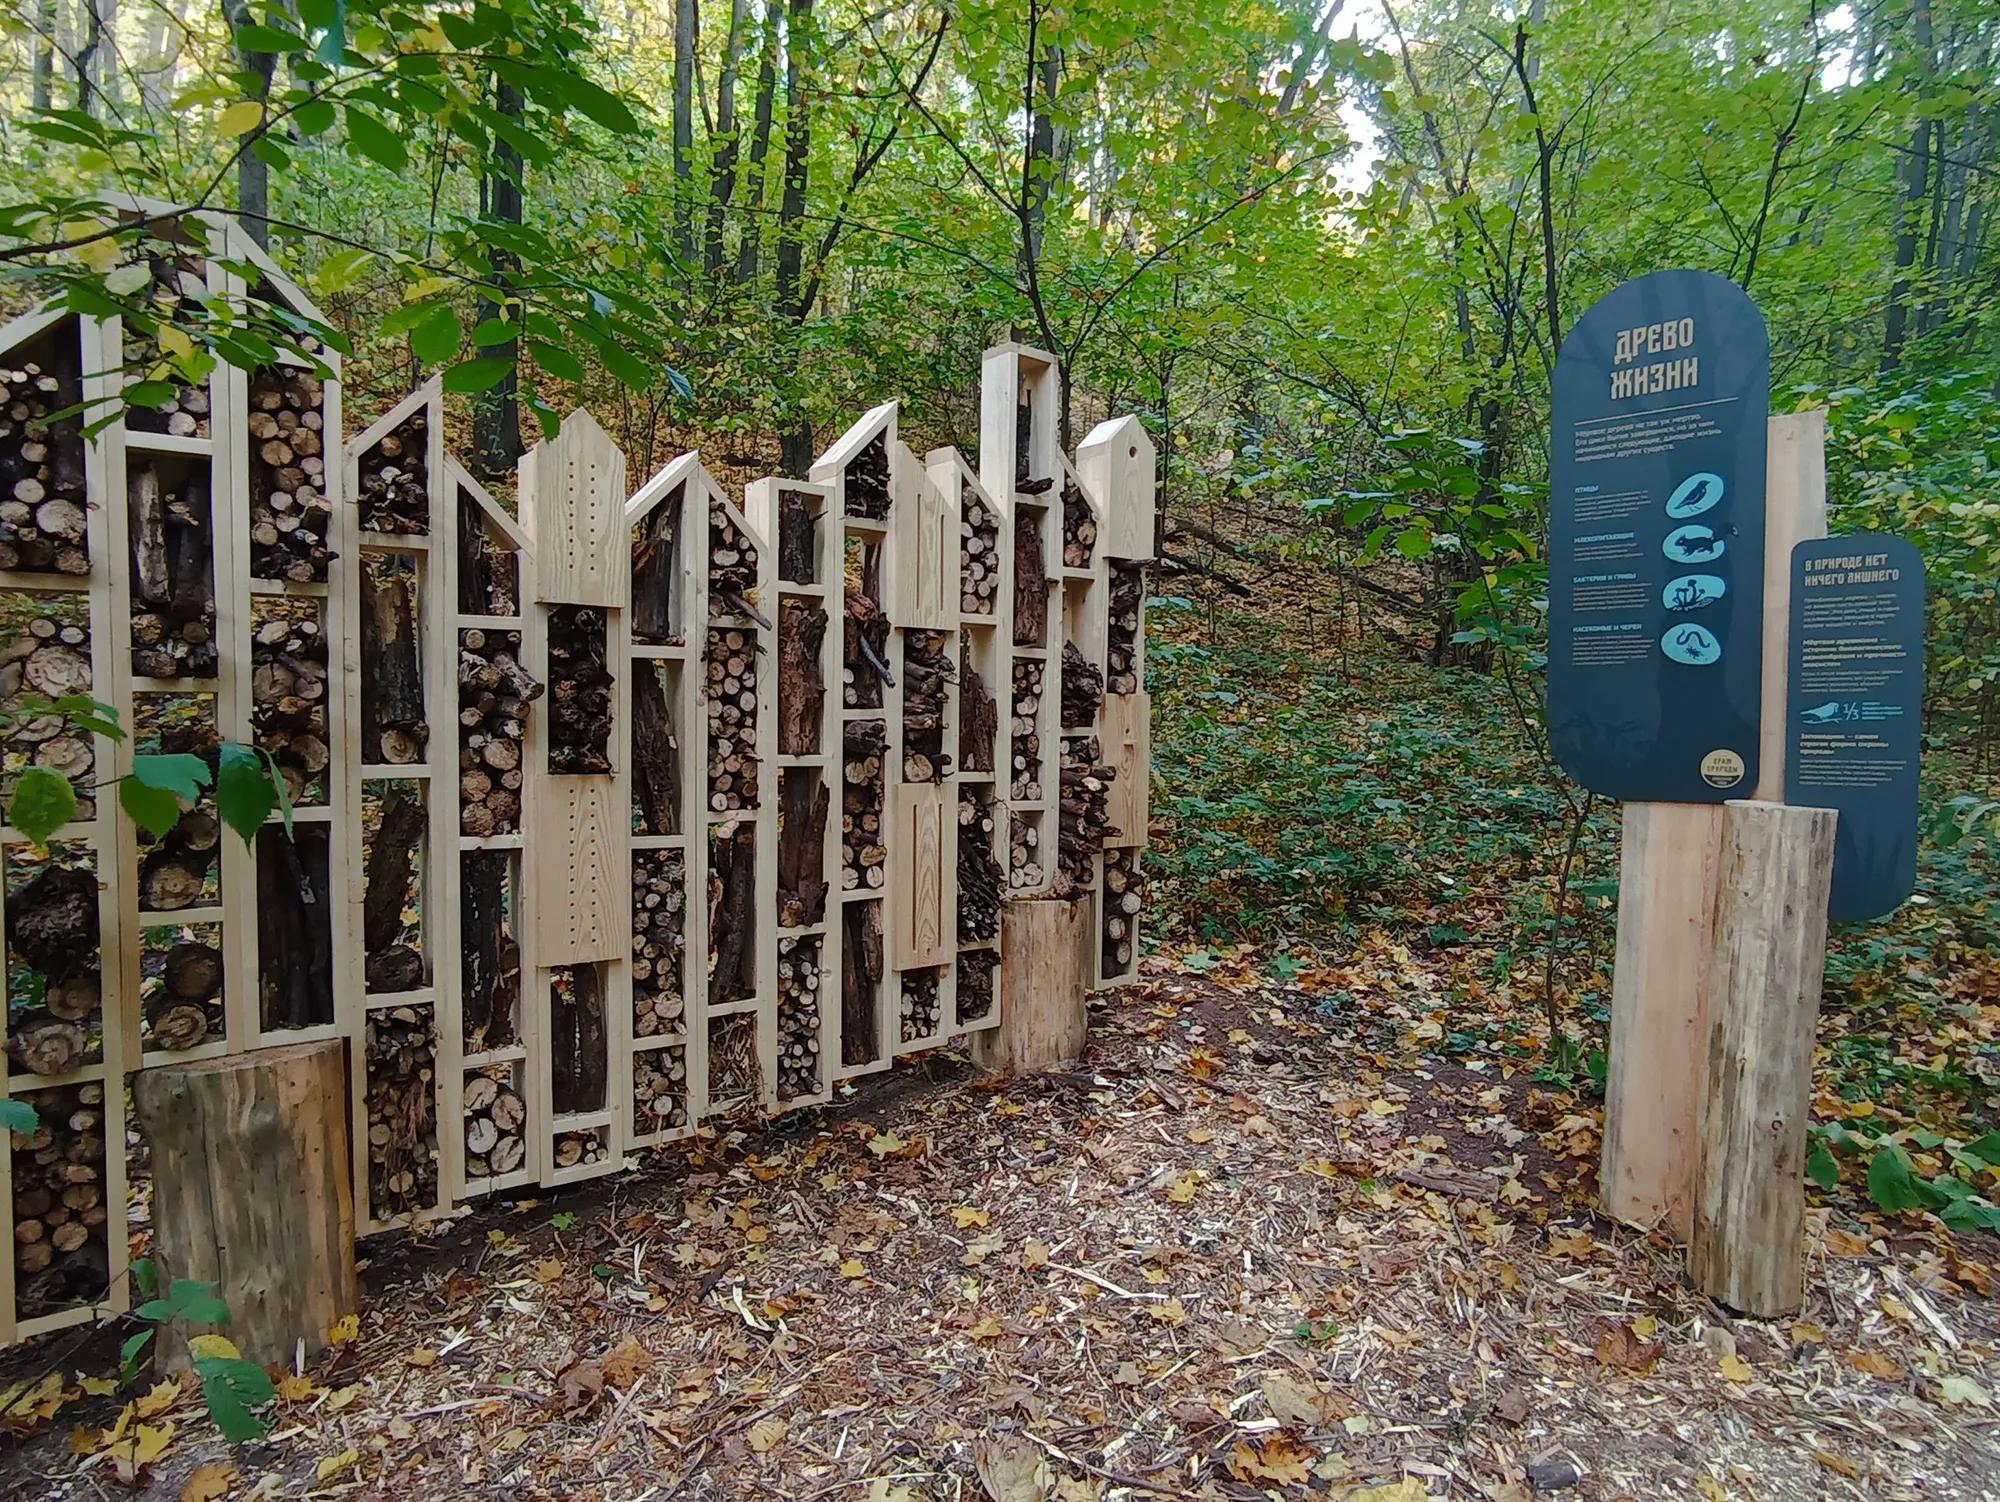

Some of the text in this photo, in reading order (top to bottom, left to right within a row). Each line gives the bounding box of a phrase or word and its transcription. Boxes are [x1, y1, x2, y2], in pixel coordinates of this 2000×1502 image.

[1614, 317, 1694, 365] ДРЕВО
[1610, 357, 1698, 400] ЖИЗНИ
[1804, 554, 1889, 571] В ПРИРОДЕ НЕТ
[1804, 569, 1900, 587] НИЧЕГО ЛИШНЕГО
